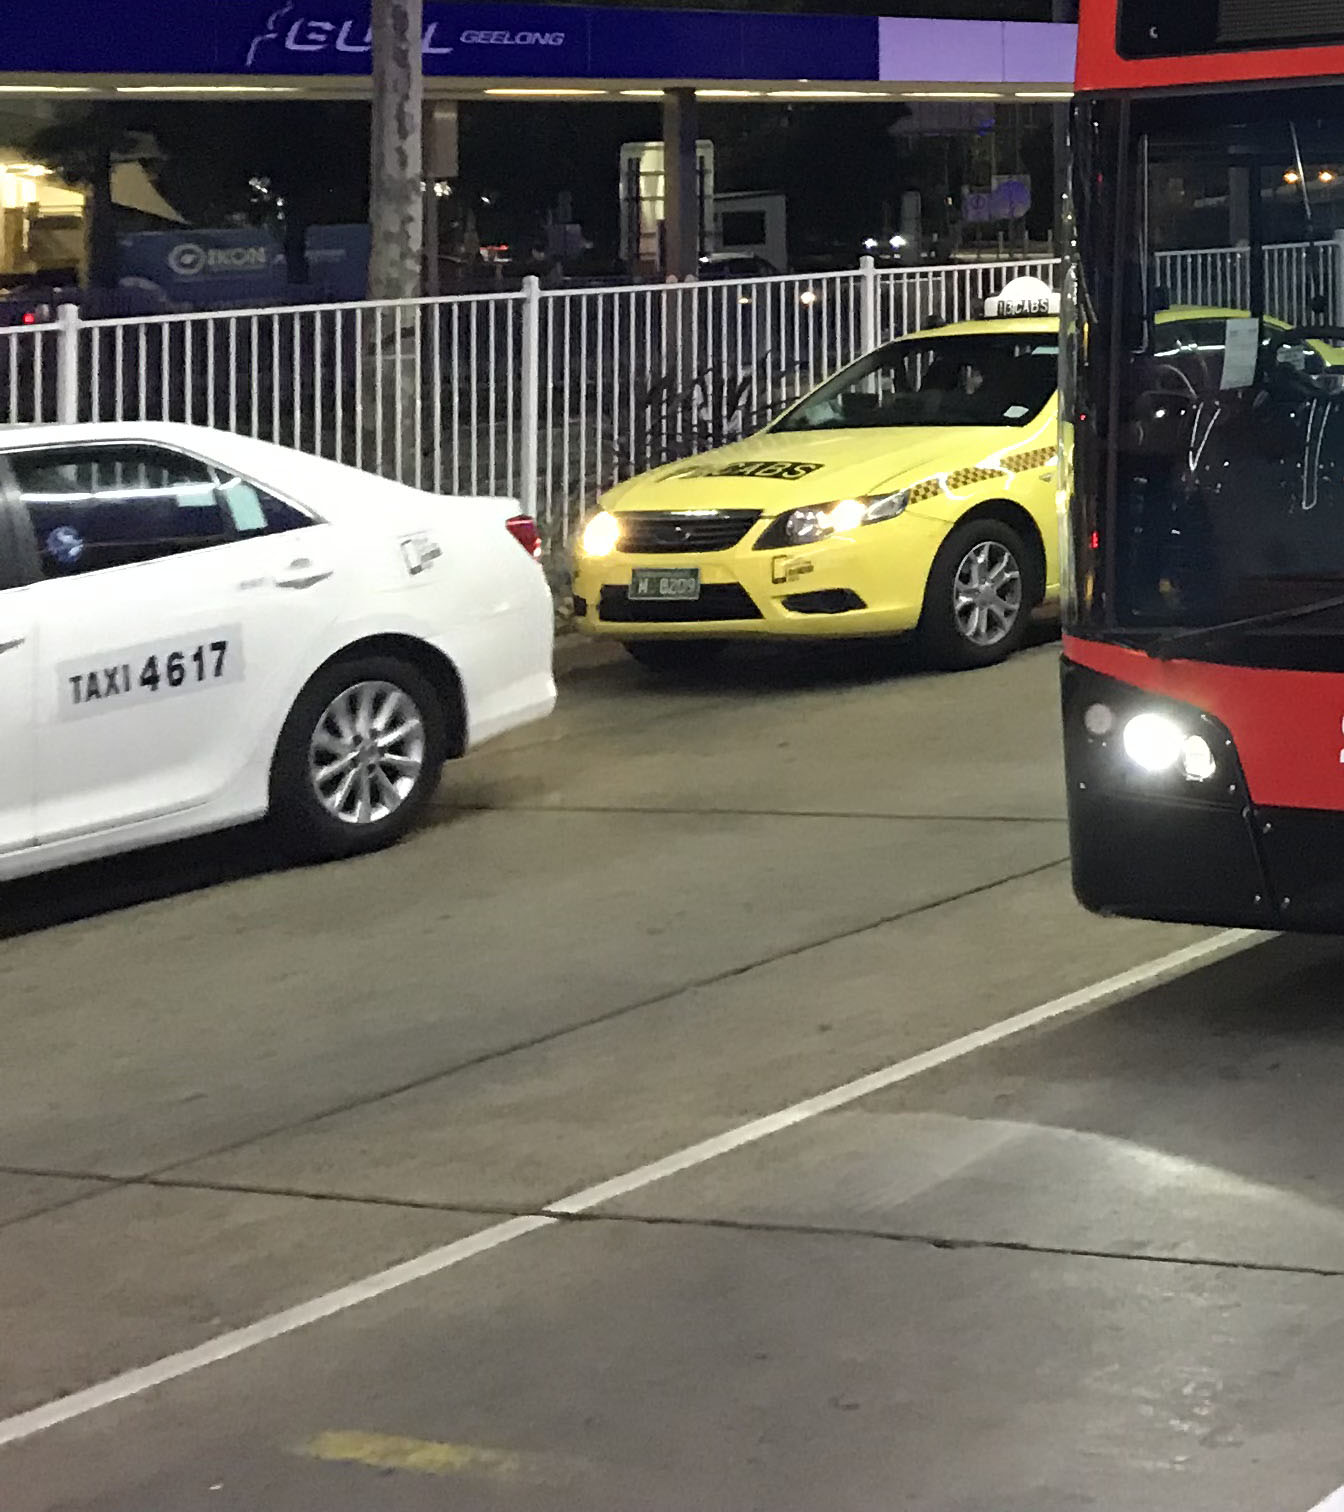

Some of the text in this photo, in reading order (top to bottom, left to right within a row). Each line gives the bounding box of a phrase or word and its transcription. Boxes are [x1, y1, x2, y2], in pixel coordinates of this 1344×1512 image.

[460, 30, 565, 46] GEELONG
[207, 247, 266, 266] IKON
[69, 640, 227, 704] TAXI 4617
